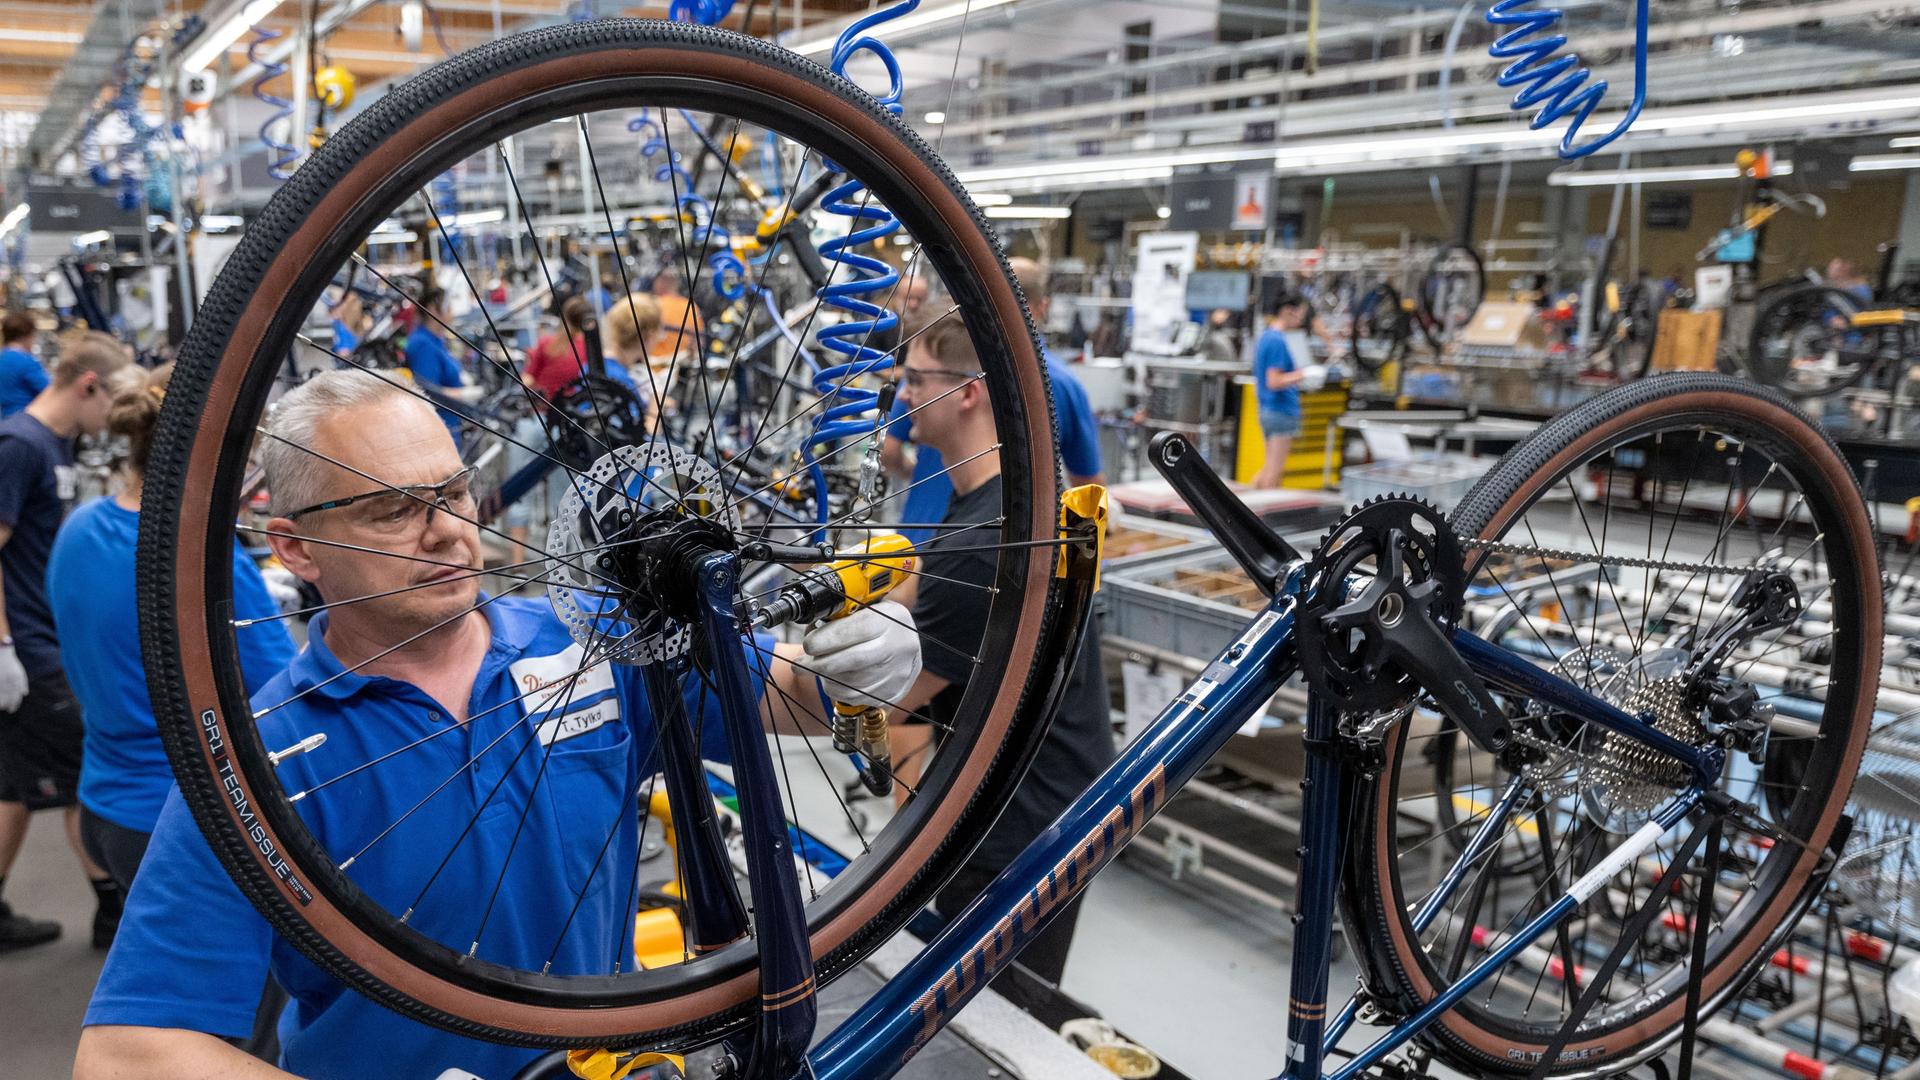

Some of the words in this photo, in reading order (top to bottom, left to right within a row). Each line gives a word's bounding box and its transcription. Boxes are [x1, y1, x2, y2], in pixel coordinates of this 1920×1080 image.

[1454, 679, 1488, 719] GRX
[201, 709, 222, 755] GR1
[219, 759, 255, 824] TEAM
[248, 819, 291, 879] ISSUE
[1560, 1048, 1590, 1062] ISSUE
